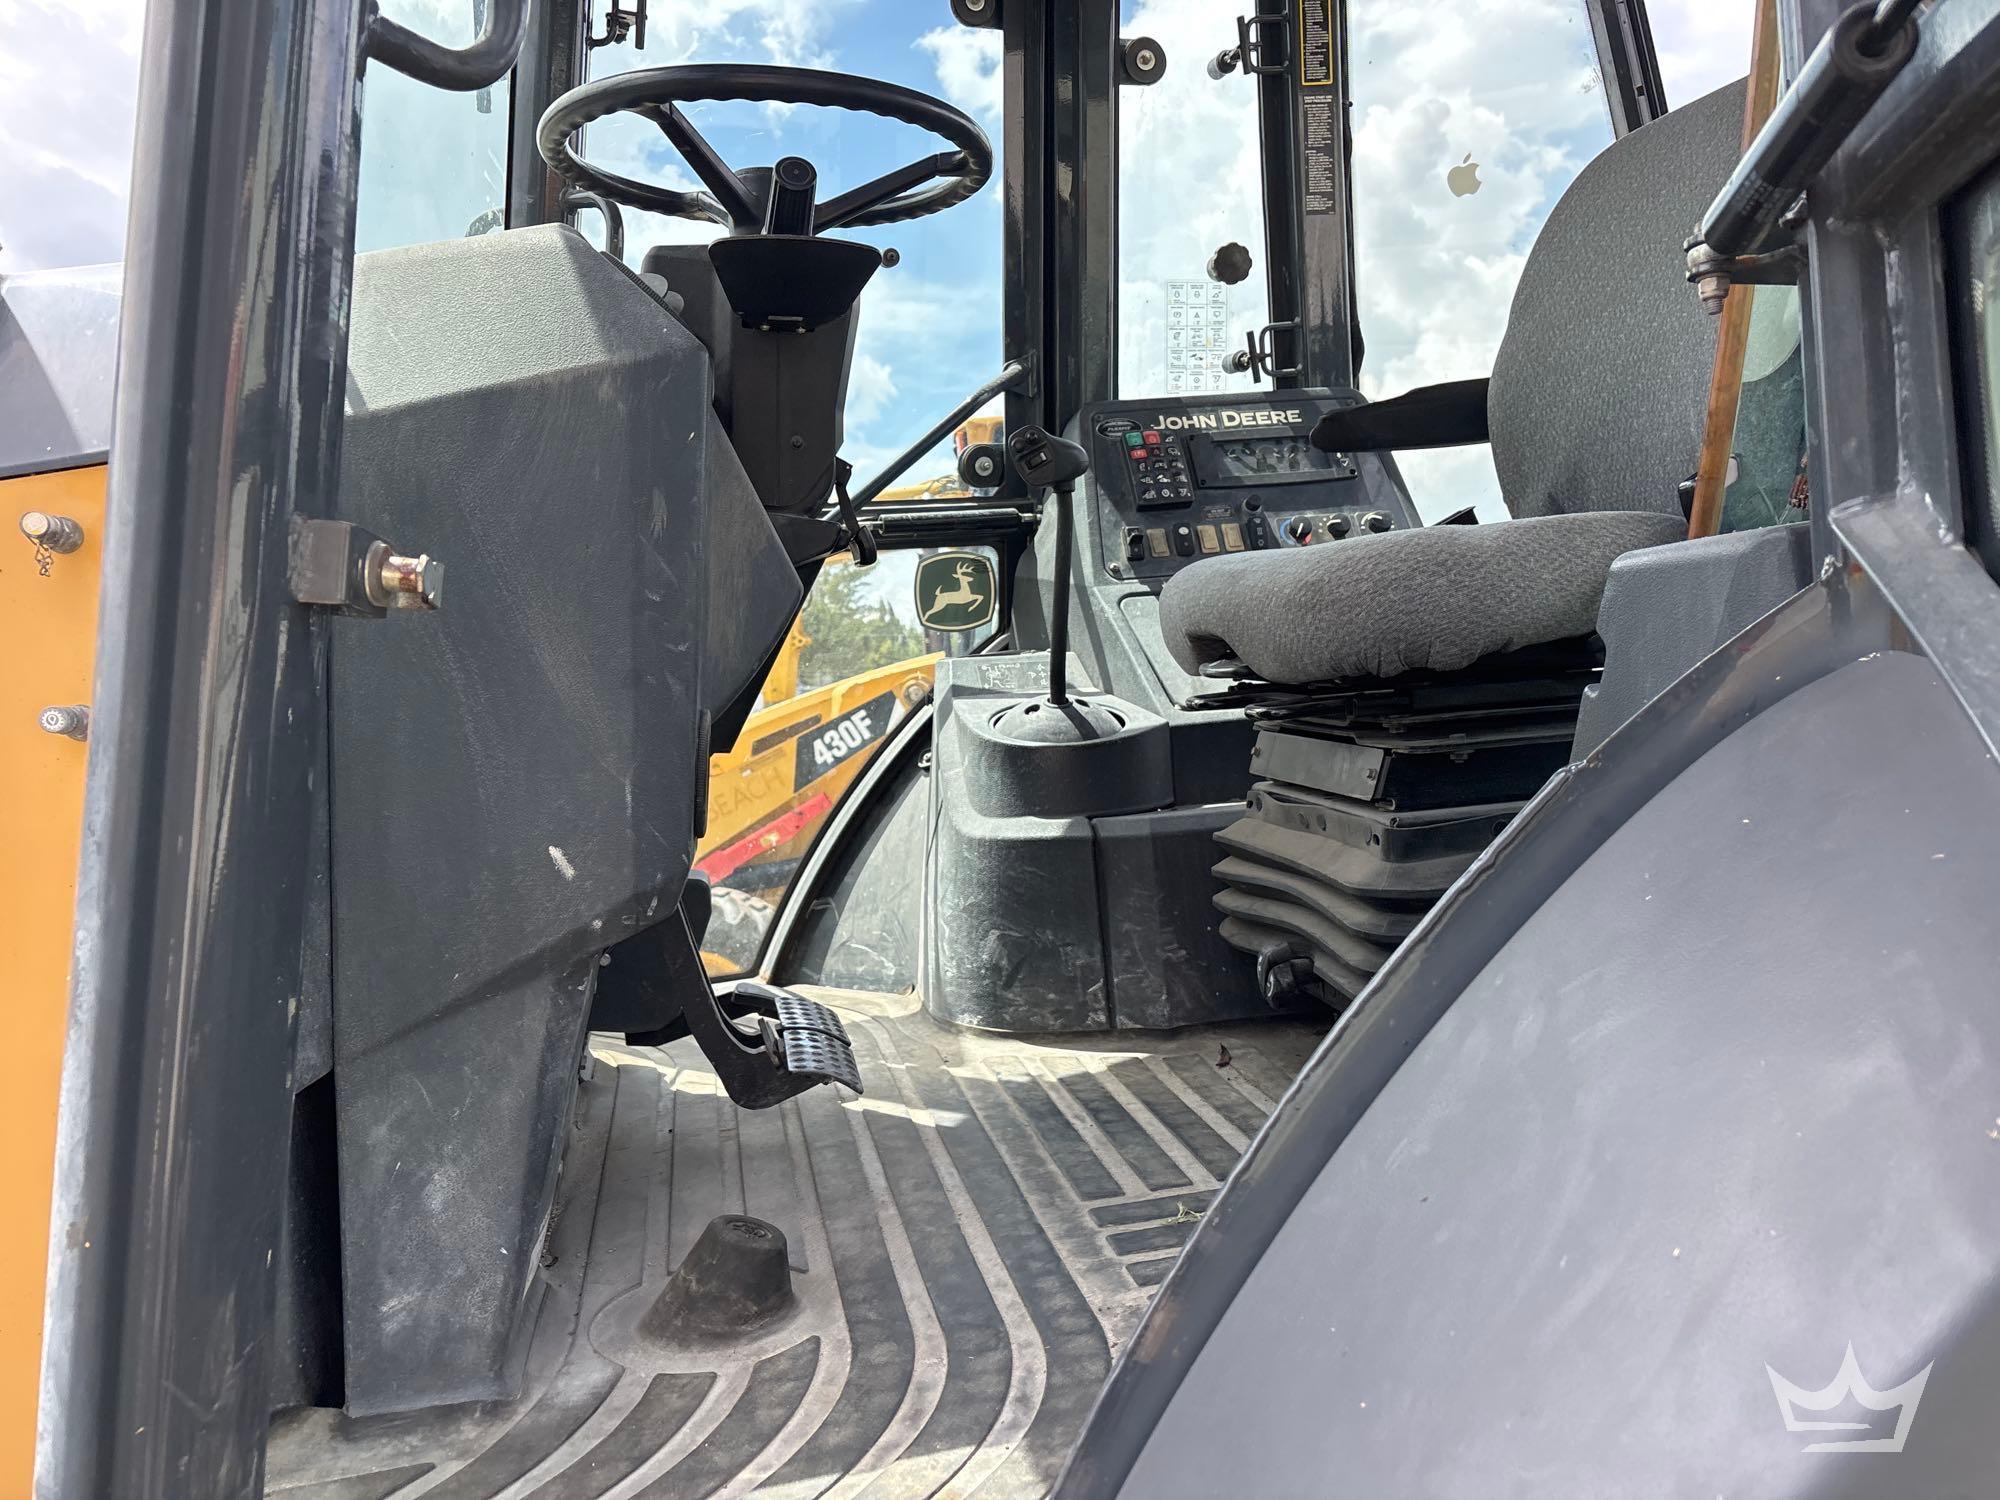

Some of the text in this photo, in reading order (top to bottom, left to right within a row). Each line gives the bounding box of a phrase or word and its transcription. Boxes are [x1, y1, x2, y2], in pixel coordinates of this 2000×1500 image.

[1151, 414, 1218, 430] JOHN
[1221, 409, 1302, 427] DEERE
[813, 709, 872, 765] 430F
